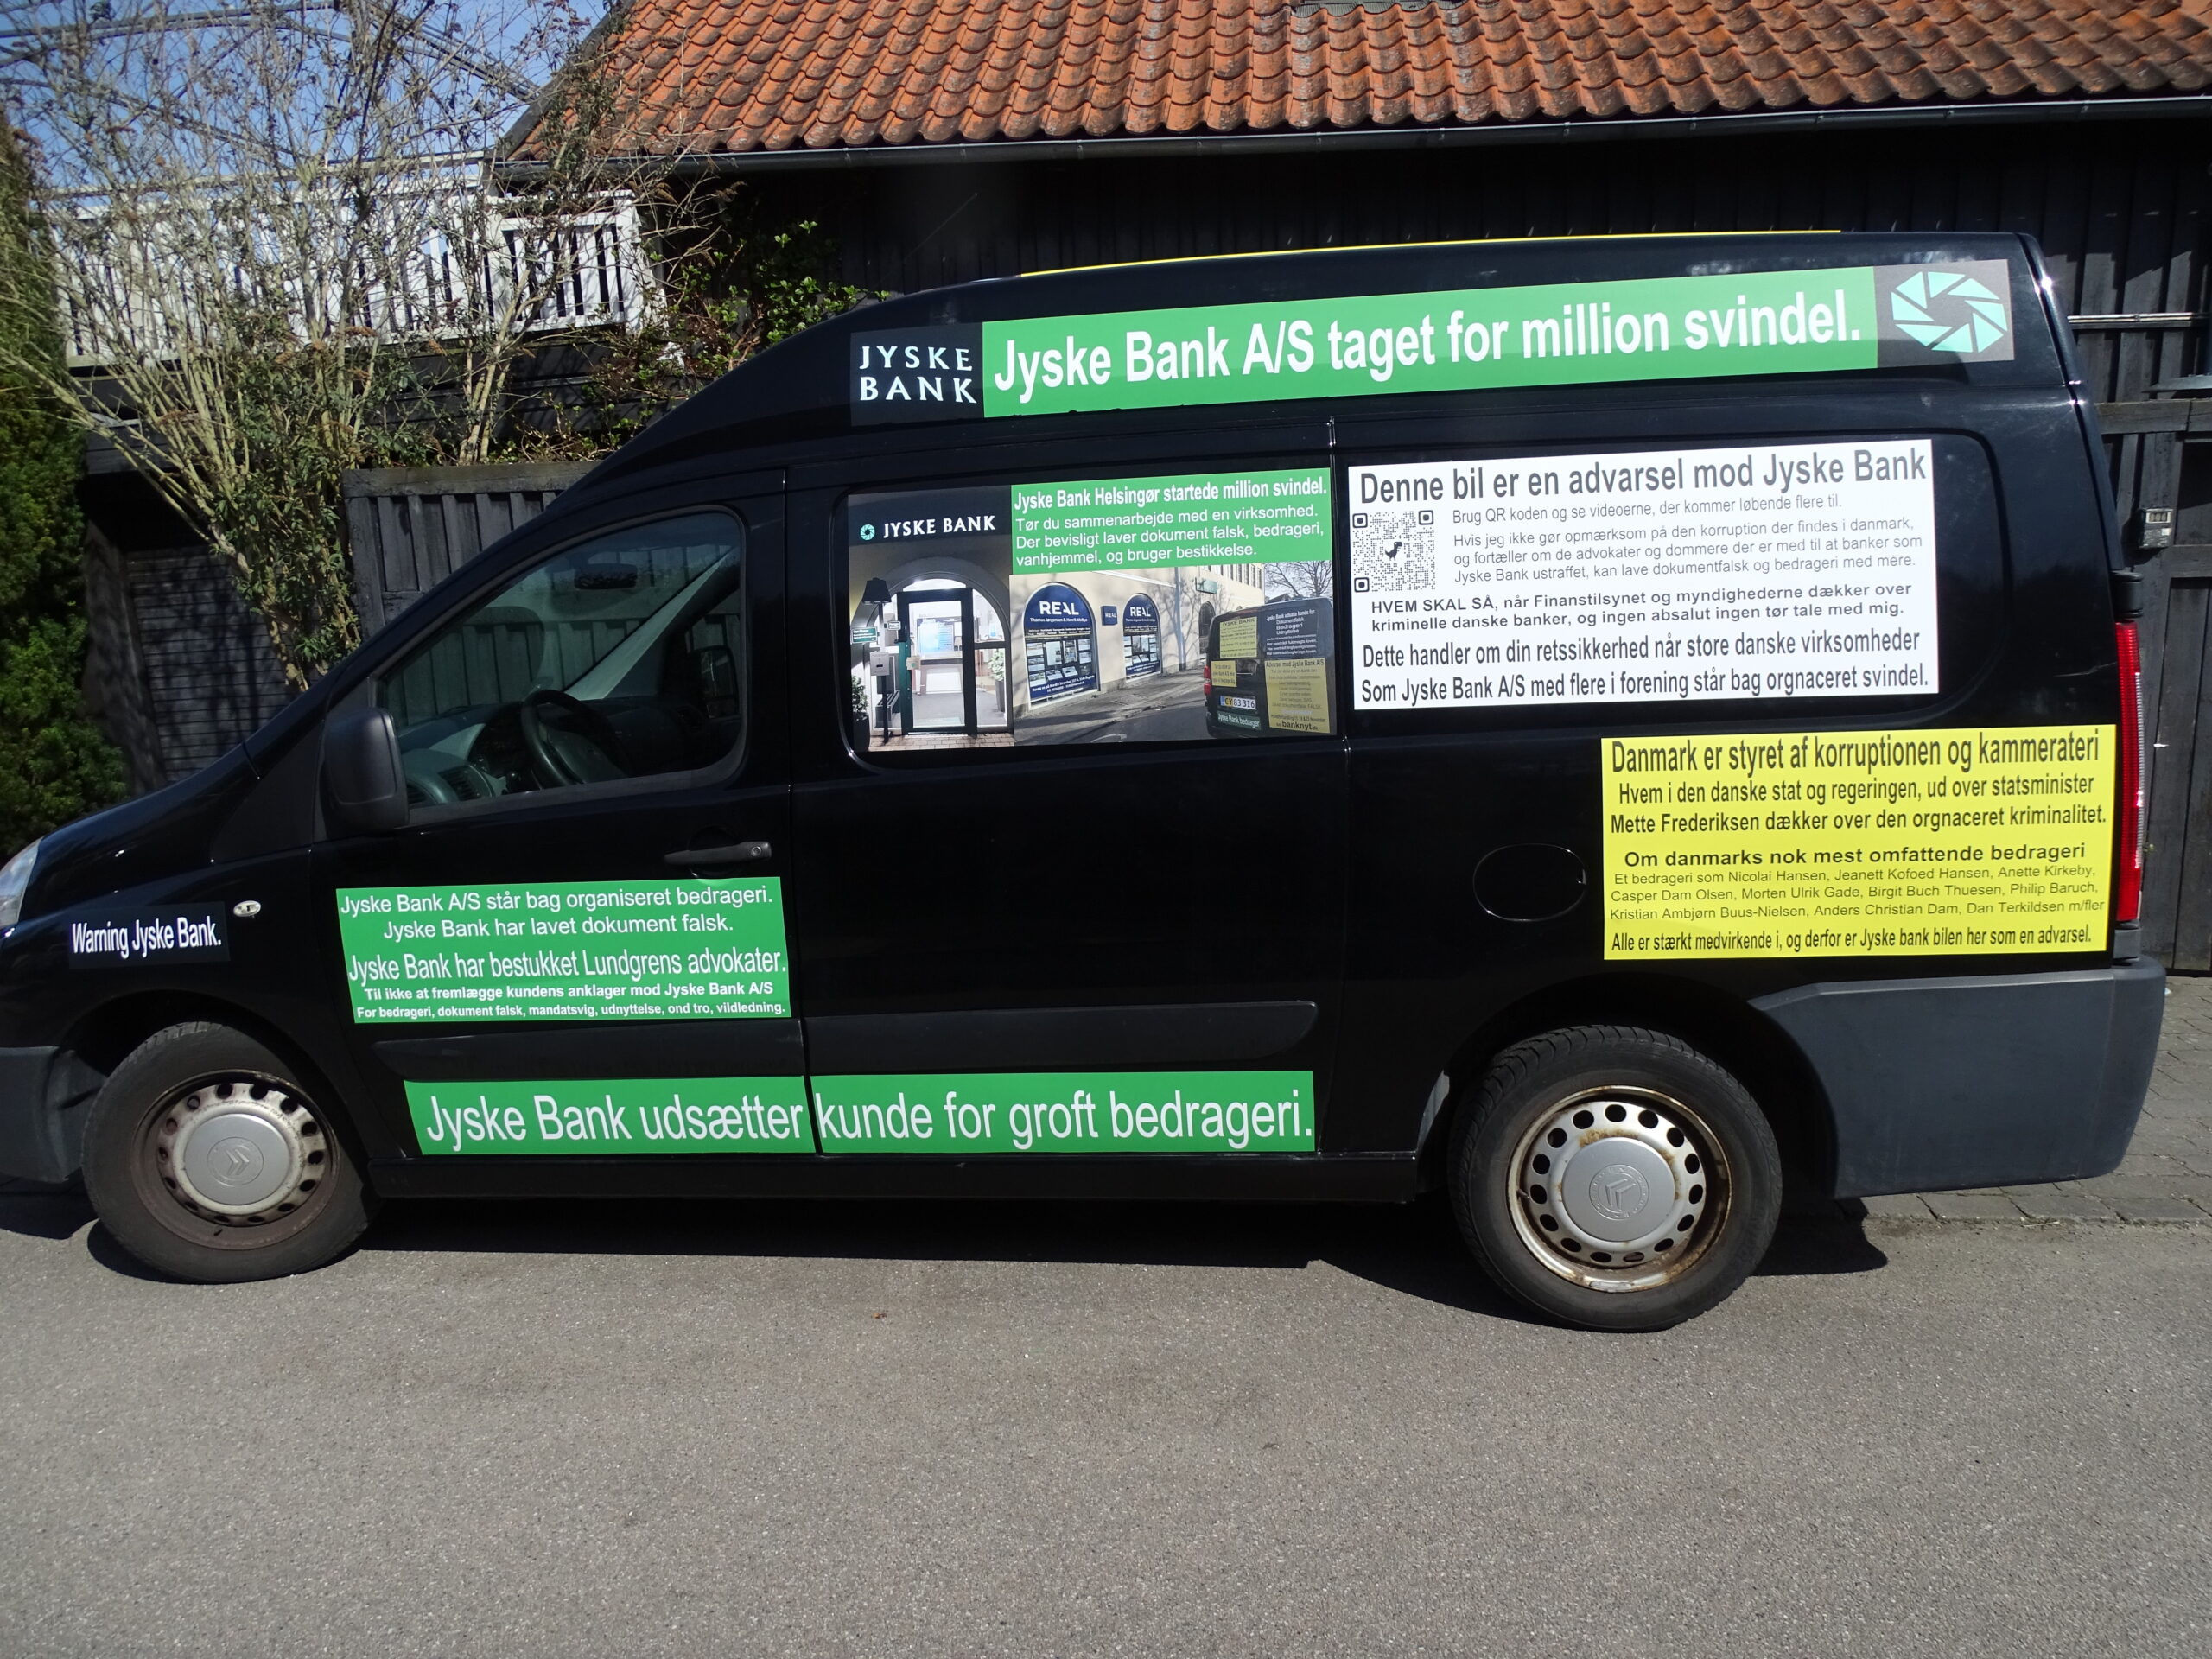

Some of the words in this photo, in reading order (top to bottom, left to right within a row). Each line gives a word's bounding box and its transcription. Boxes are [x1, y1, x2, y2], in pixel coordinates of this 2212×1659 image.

[859, 346, 973, 372] JYSKE
[994, 335, 1111, 404] Jyske
[1126, 326, 1230, 382] Bank
[1242, 319, 1314, 375] A/S
[1327, 314, 1436, 382] taget
[1446, 309, 1510, 363] for
[1522, 302, 1669, 359] million
[1683, 288, 1861, 352] svindel.
[860, 376, 977, 404] BANK
[1361, 473, 1444, 504] Denne
[1452, 467, 1484, 499] bil
[1493, 473, 1520, 498] er
[1528, 471, 1559, 496] en
[1569, 458, 1683, 494] advarsel
[1694, 454, 1753, 488] mod
[1763, 451, 1844, 494] Jyske
[1854, 448, 1926, 482] Bank
[1014, 491, 1053, 514] Jyske
[1057, 488, 1091, 508] Bank
[1095, 486, 1160, 508] Helsingør
[1163, 481, 1219, 502] startede
[1223, 480, 1269, 499] million
[1273, 476, 1327, 497] svindel.
[1452, 509, 1482, 526] Brug
[1485, 507, 1506, 523] QR
[1510, 506, 1548, 521] koden
[1551, 508, 1567, 523] og
[1571, 507, 1586, 518] se
[1589, 503, 1655, 518] videoerne,
[1659, 500, 1681, 515] der
[1684, 499, 1736, 513] kommer
[1739, 496, 1791, 512] løbende
[1796, 494, 1824, 509] flere
[1827, 493, 1841, 508] til.
[883, 519, 937, 538] JYSKE
[943, 516, 995, 533] BANK
[1015, 518, 1039, 531] Tør
[1043, 517, 1060, 530] du
[1064, 511, 1174, 529] sammenarbejde
[1178, 509, 1208, 523] med
[1211, 511, 1230, 521] en
[1233, 504, 1318, 520] virksomhed.
[1016, 536, 1041, 549] Der
[1044, 532, 1100, 549] bevisligt
[1103, 531, 1137, 544] laver
[1141, 527, 1209, 543] dokument
[1211, 524, 1249, 539] falsk,
[1253, 521, 1324, 538] bedrageri,
[1016, 550, 1102, 569] vanhjemmel,
[1106, 551, 1123, 565] og
[1128, 548, 1173, 563] bruger
[1176, 543, 1257, 559] bestikkelse.
[1039, 601, 1079, 616] REAL
[1129, 606, 1152, 617] REAL
[1363, 645, 1404, 668] Dette
[1409, 641, 1471, 666] handler
[1476, 645, 1500, 664] om
[1506, 639, 1531, 663] din
[1536, 634, 1649, 662] retssikkerhed
[1655, 632, 1681, 658] når
[1687, 634, 1729, 657] store
[1735, 631, 1796, 656] danske
[1801, 626, 1920, 653] virksomheder
[1612, 740, 1699, 773] Danmark
[1703, 745, 1723, 772] er
[1729, 739, 1784, 777] styret
[1790, 735, 1808, 769] af
[1815, 734, 1941, 774] korruptionen
[1948, 740, 1972, 772] og
[1979, 728, 2101, 764] kammerateri
[1624, 851, 1658, 868] Om
[1665, 849, 1763, 867] danmarks
[1770, 849, 1807, 864] nok
[1814, 849, 1863, 863] mest
[1869, 845, 1984, 862] omfattende
[1991, 842, 2085, 863] bedrageri
[340, 895, 391, 918] Jyske
[397, 893, 444, 912] Bank
[448, 892, 481, 911] A/S
[486, 890, 521, 910] står
[525, 891, 561, 912] bag
[566, 887, 672, 912] organiseret
[676, 885, 772, 908] bedrageri.
[1611, 890, 1658, 904] Casper
[1662, 889, 1692, 901] Dam
[1695, 888, 1737, 900] Olsen,
[1742, 887, 1786, 899] Morten
[1791, 887, 1820, 899] Ulrik
[1824, 886, 1864, 899] Gade,
[1868, 886, 1902, 899] Birgit
[1906, 885, 1940, 897] Buch
[1944, 884, 2005, 896] Thuesen,
[2010, 883, 2045, 897] Philip
[2050, 881, 2098, 893] Baruch,
[72, 921, 130, 959] Warning
[131, 918, 175, 958] Jyske
[176, 915, 222, 948] Bank.
[384, 920, 436, 943] Jyske
[441, 918, 491, 938] Bank
[494, 918, 526, 936] har
[531, 917, 577, 935] lavet
[582, 915, 678, 934] dokument
[681, 912, 734, 931] falsk.
[348, 954, 400, 988] Jyske
[403, 952, 453, 979] Bank
[454, 952, 486, 978] har
[489, 950, 580, 978] bestukket
[582, 949, 683, 982] Lundgrens
[687, 946, 786, 975] advokater.
[364, 988, 382, 1001] Til
[385, 988, 413, 1000] ikke
[416, 988, 429, 1000] at
[431, 986, 503, 1001] fremlægge
[506, 985, 564, 998] kundens
[568, 984, 627, 1000] anklager
[630, 983, 661, 996] mod
[664, 982, 705, 999] Jyske
[709, 982, 746, 995] Bank
[748, 981, 773, 995] A/S
[356, 1007, 377, 1018] For
[378, 1006, 435, 1020] bedrageri,
[437, 1006, 494, 1017] dokument
[494, 1005, 526, 1017] falsk,
[528, 1003, 599, 1018] mandatsvig,
[601, 1002, 665, 1017] udnyttelse,
[667, 1002, 691, 1014] ond
[692, 1003, 714, 1014] tro,
[715, 1001, 785, 1015] vildledning.
[426, 1095, 527, 1152] Jyske
[533, 1094, 632, 1141] Bank
[639, 1093, 804, 1140] udsætter
[815, 1092, 933, 1139] kunde
[943, 1090, 996, 1139] for
[1009, 1090, 1099, 1150] groft
[1109, 1089, 1313, 1149] bedrageri.
